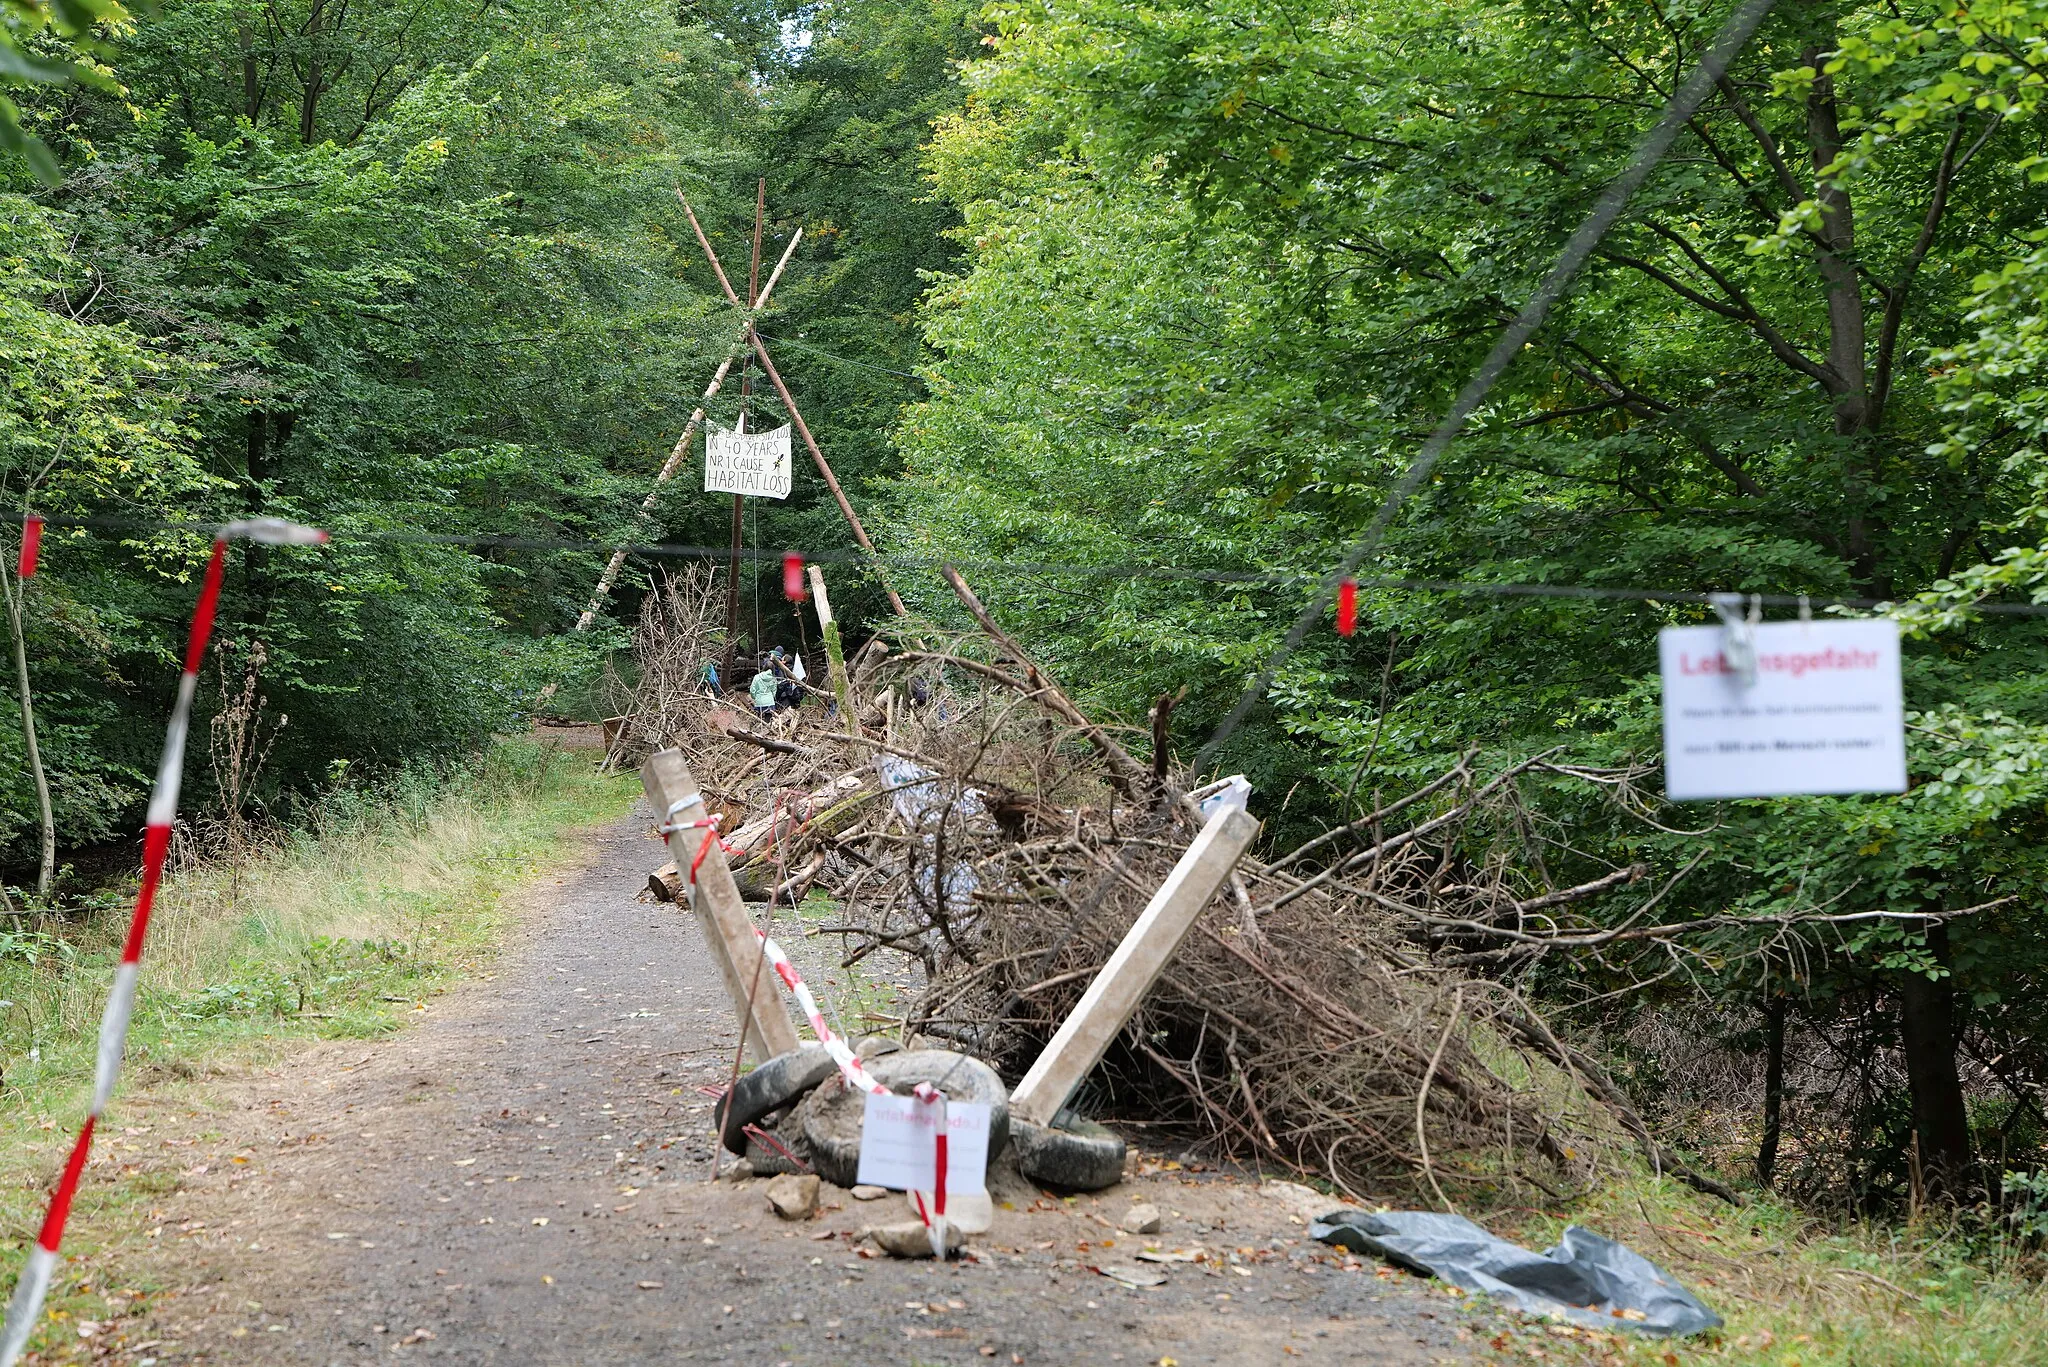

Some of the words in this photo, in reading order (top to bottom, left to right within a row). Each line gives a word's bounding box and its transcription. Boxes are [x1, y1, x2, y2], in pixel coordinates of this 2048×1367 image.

[724, 439, 741, 455] 40
[746, 440, 779, 456] YEARS
[709, 455, 724, 467] NR
[725, 456, 730, 469] 1
[733, 456, 764, 472] CAUSE
[707, 470, 762, 490] HABITAT
[763, 473, 789, 495] LOSS
[1680, 648, 1879, 677] Lebnsgefahr
